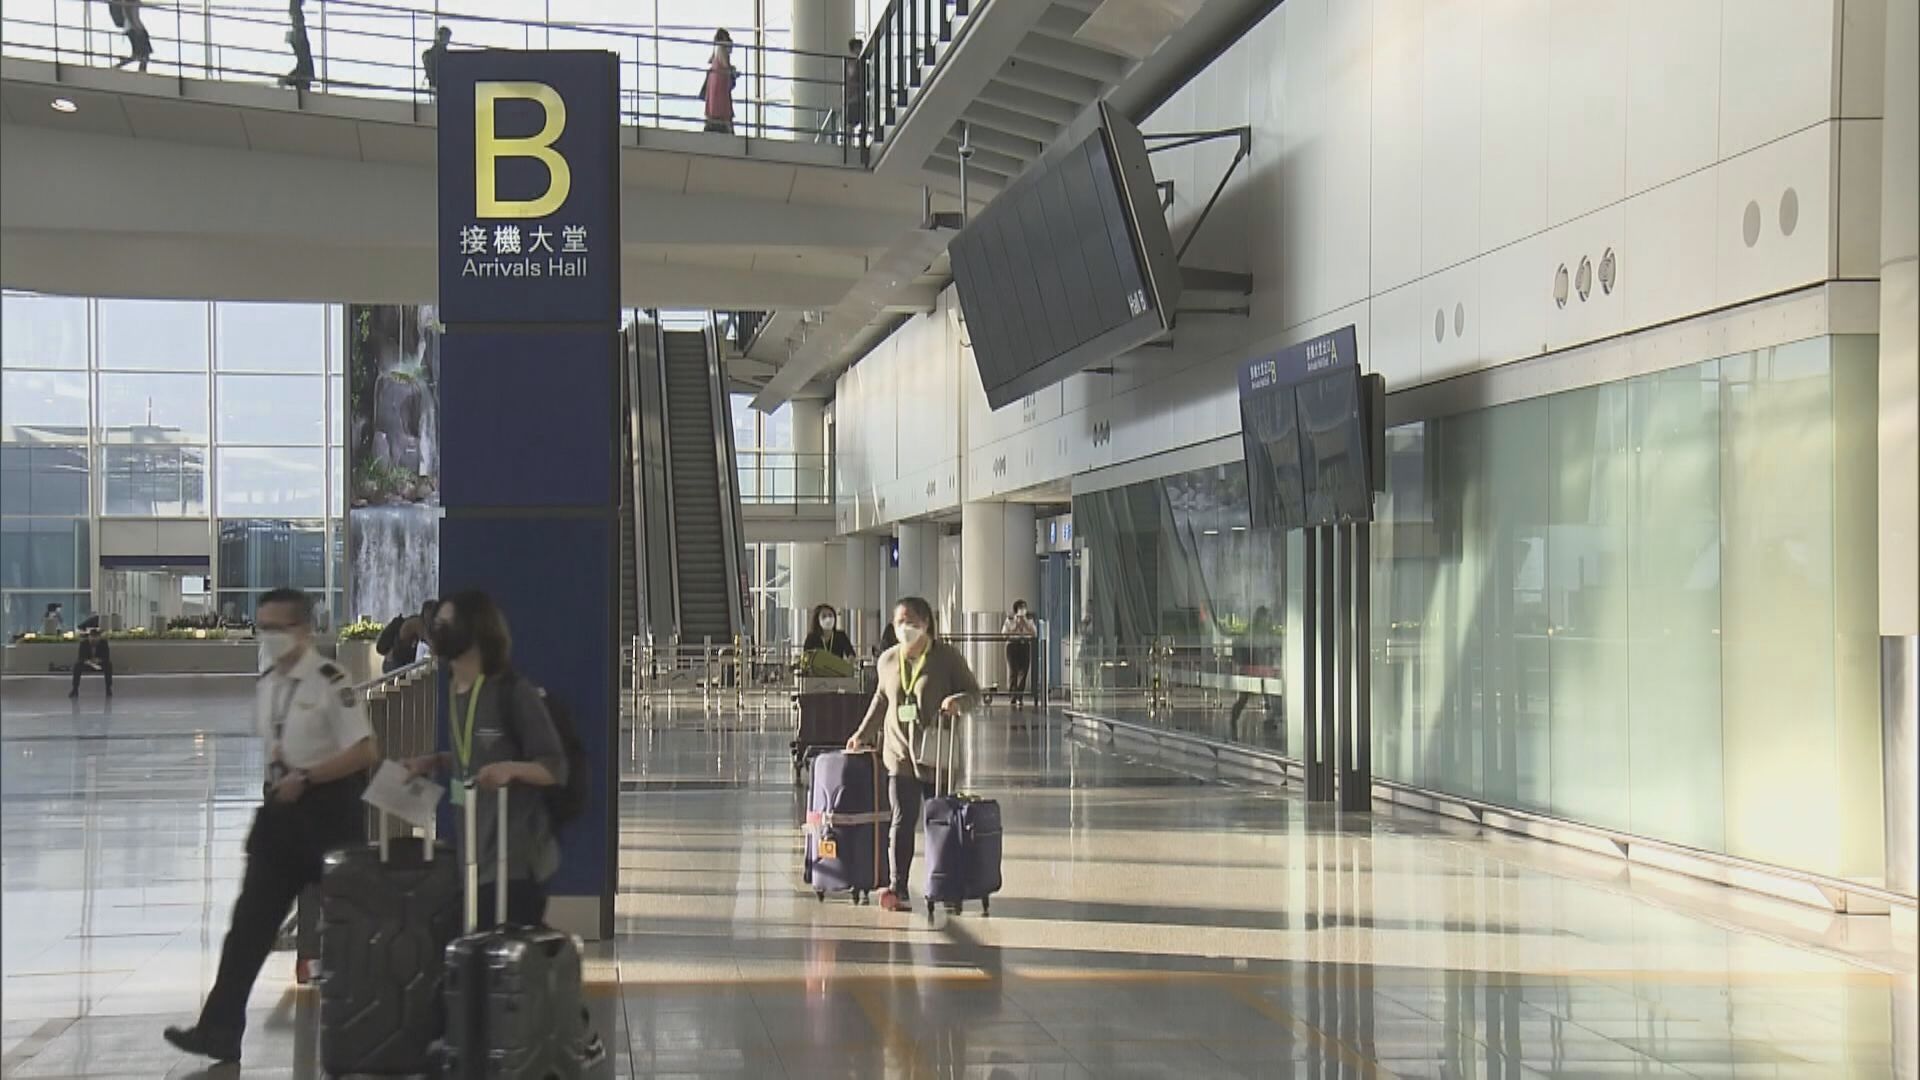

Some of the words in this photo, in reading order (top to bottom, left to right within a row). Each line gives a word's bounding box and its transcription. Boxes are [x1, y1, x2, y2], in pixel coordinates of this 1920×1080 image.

[475, 81, 571, 218] B
[460, 225, 588, 254] 接機大堂
[462, 257, 541, 277] Arrivals
[549, 258, 587, 277] Hall
[1331, 339, 1338, 365] A
